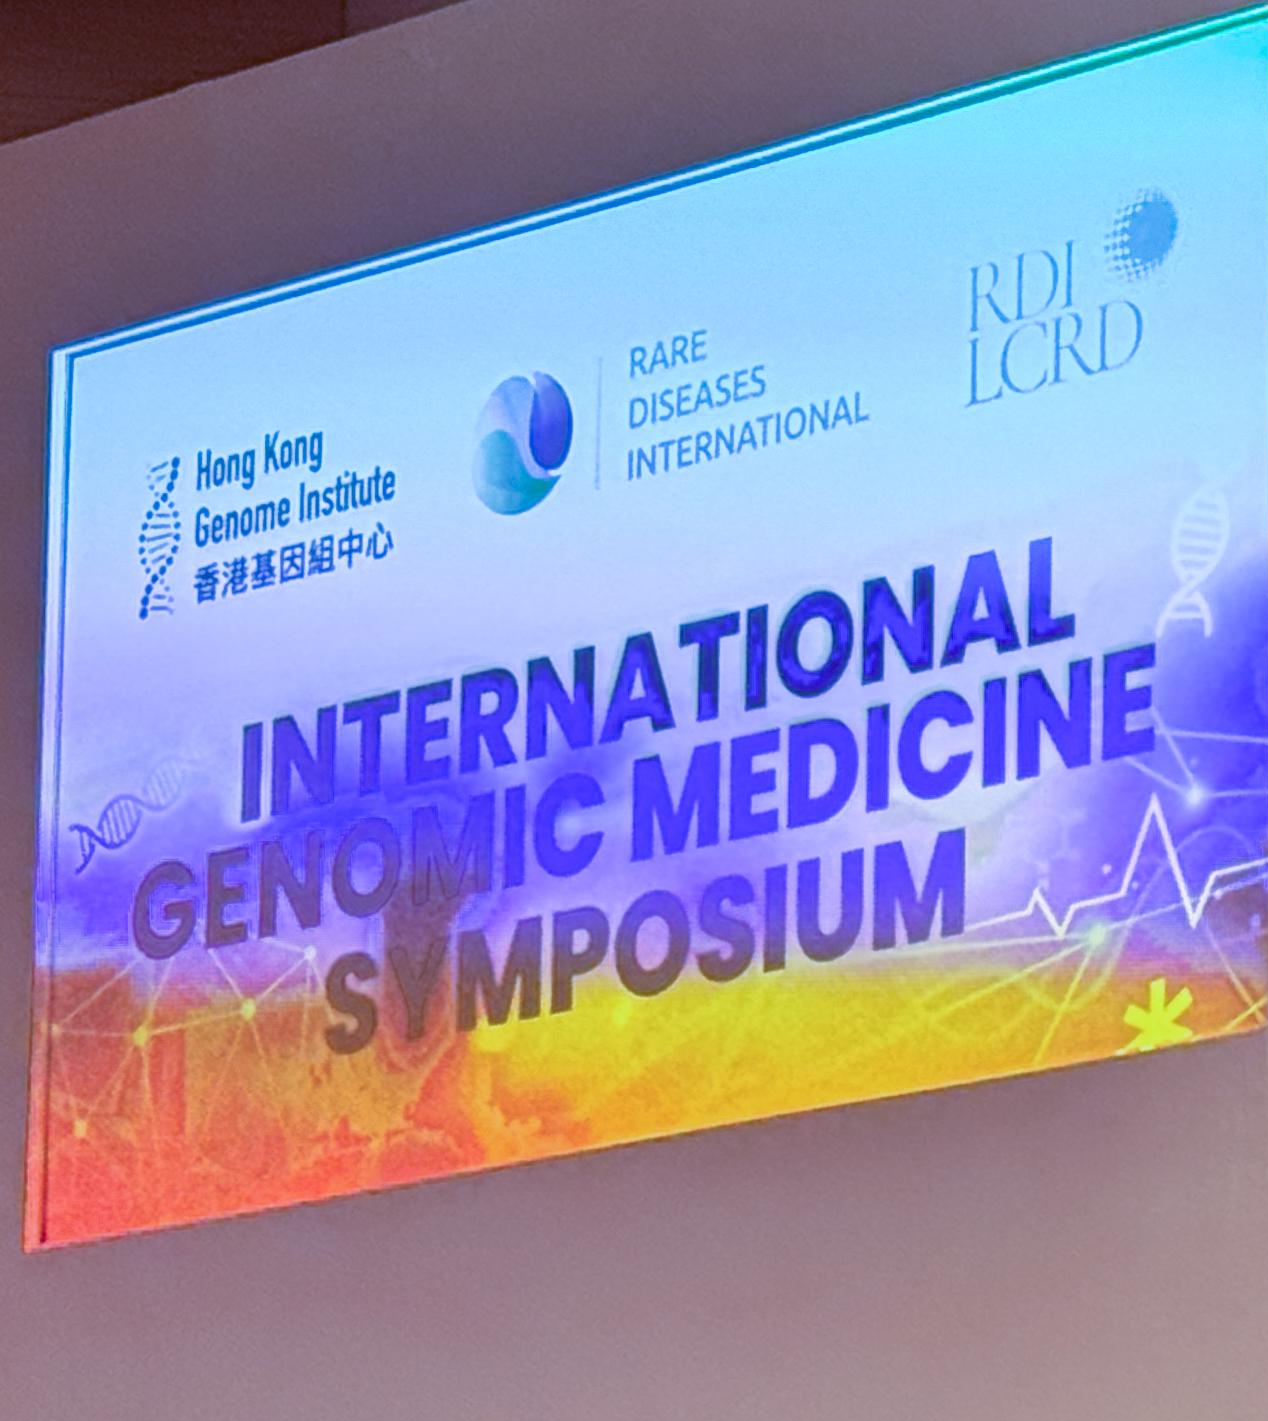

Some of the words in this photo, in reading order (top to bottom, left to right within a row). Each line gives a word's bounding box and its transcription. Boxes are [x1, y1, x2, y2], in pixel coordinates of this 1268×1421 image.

[968, 239, 1076, 332] RDI
[628, 365, 767, 430] DISEASES
[629, 330, 708, 379] RARE
[964, 299, 1144, 408] LCRD
[196, 448, 255, 491] Hong
[263, 430, 324, 473] Kong
[626, 391, 870, 481] INTERNATIONAL
[194, 497, 290, 548] Genome
[298, 465, 396, 523] Institute
[193, 521, 395, 604] 香港基因組中心
[240, 537, 1076, 822] INTERNATIONAL
[132, 771, 604, 960] GENOMIC
[629, 643, 1157, 861] MEDICINE
[325, 826, 966, 1055] SYMPOSIUM
